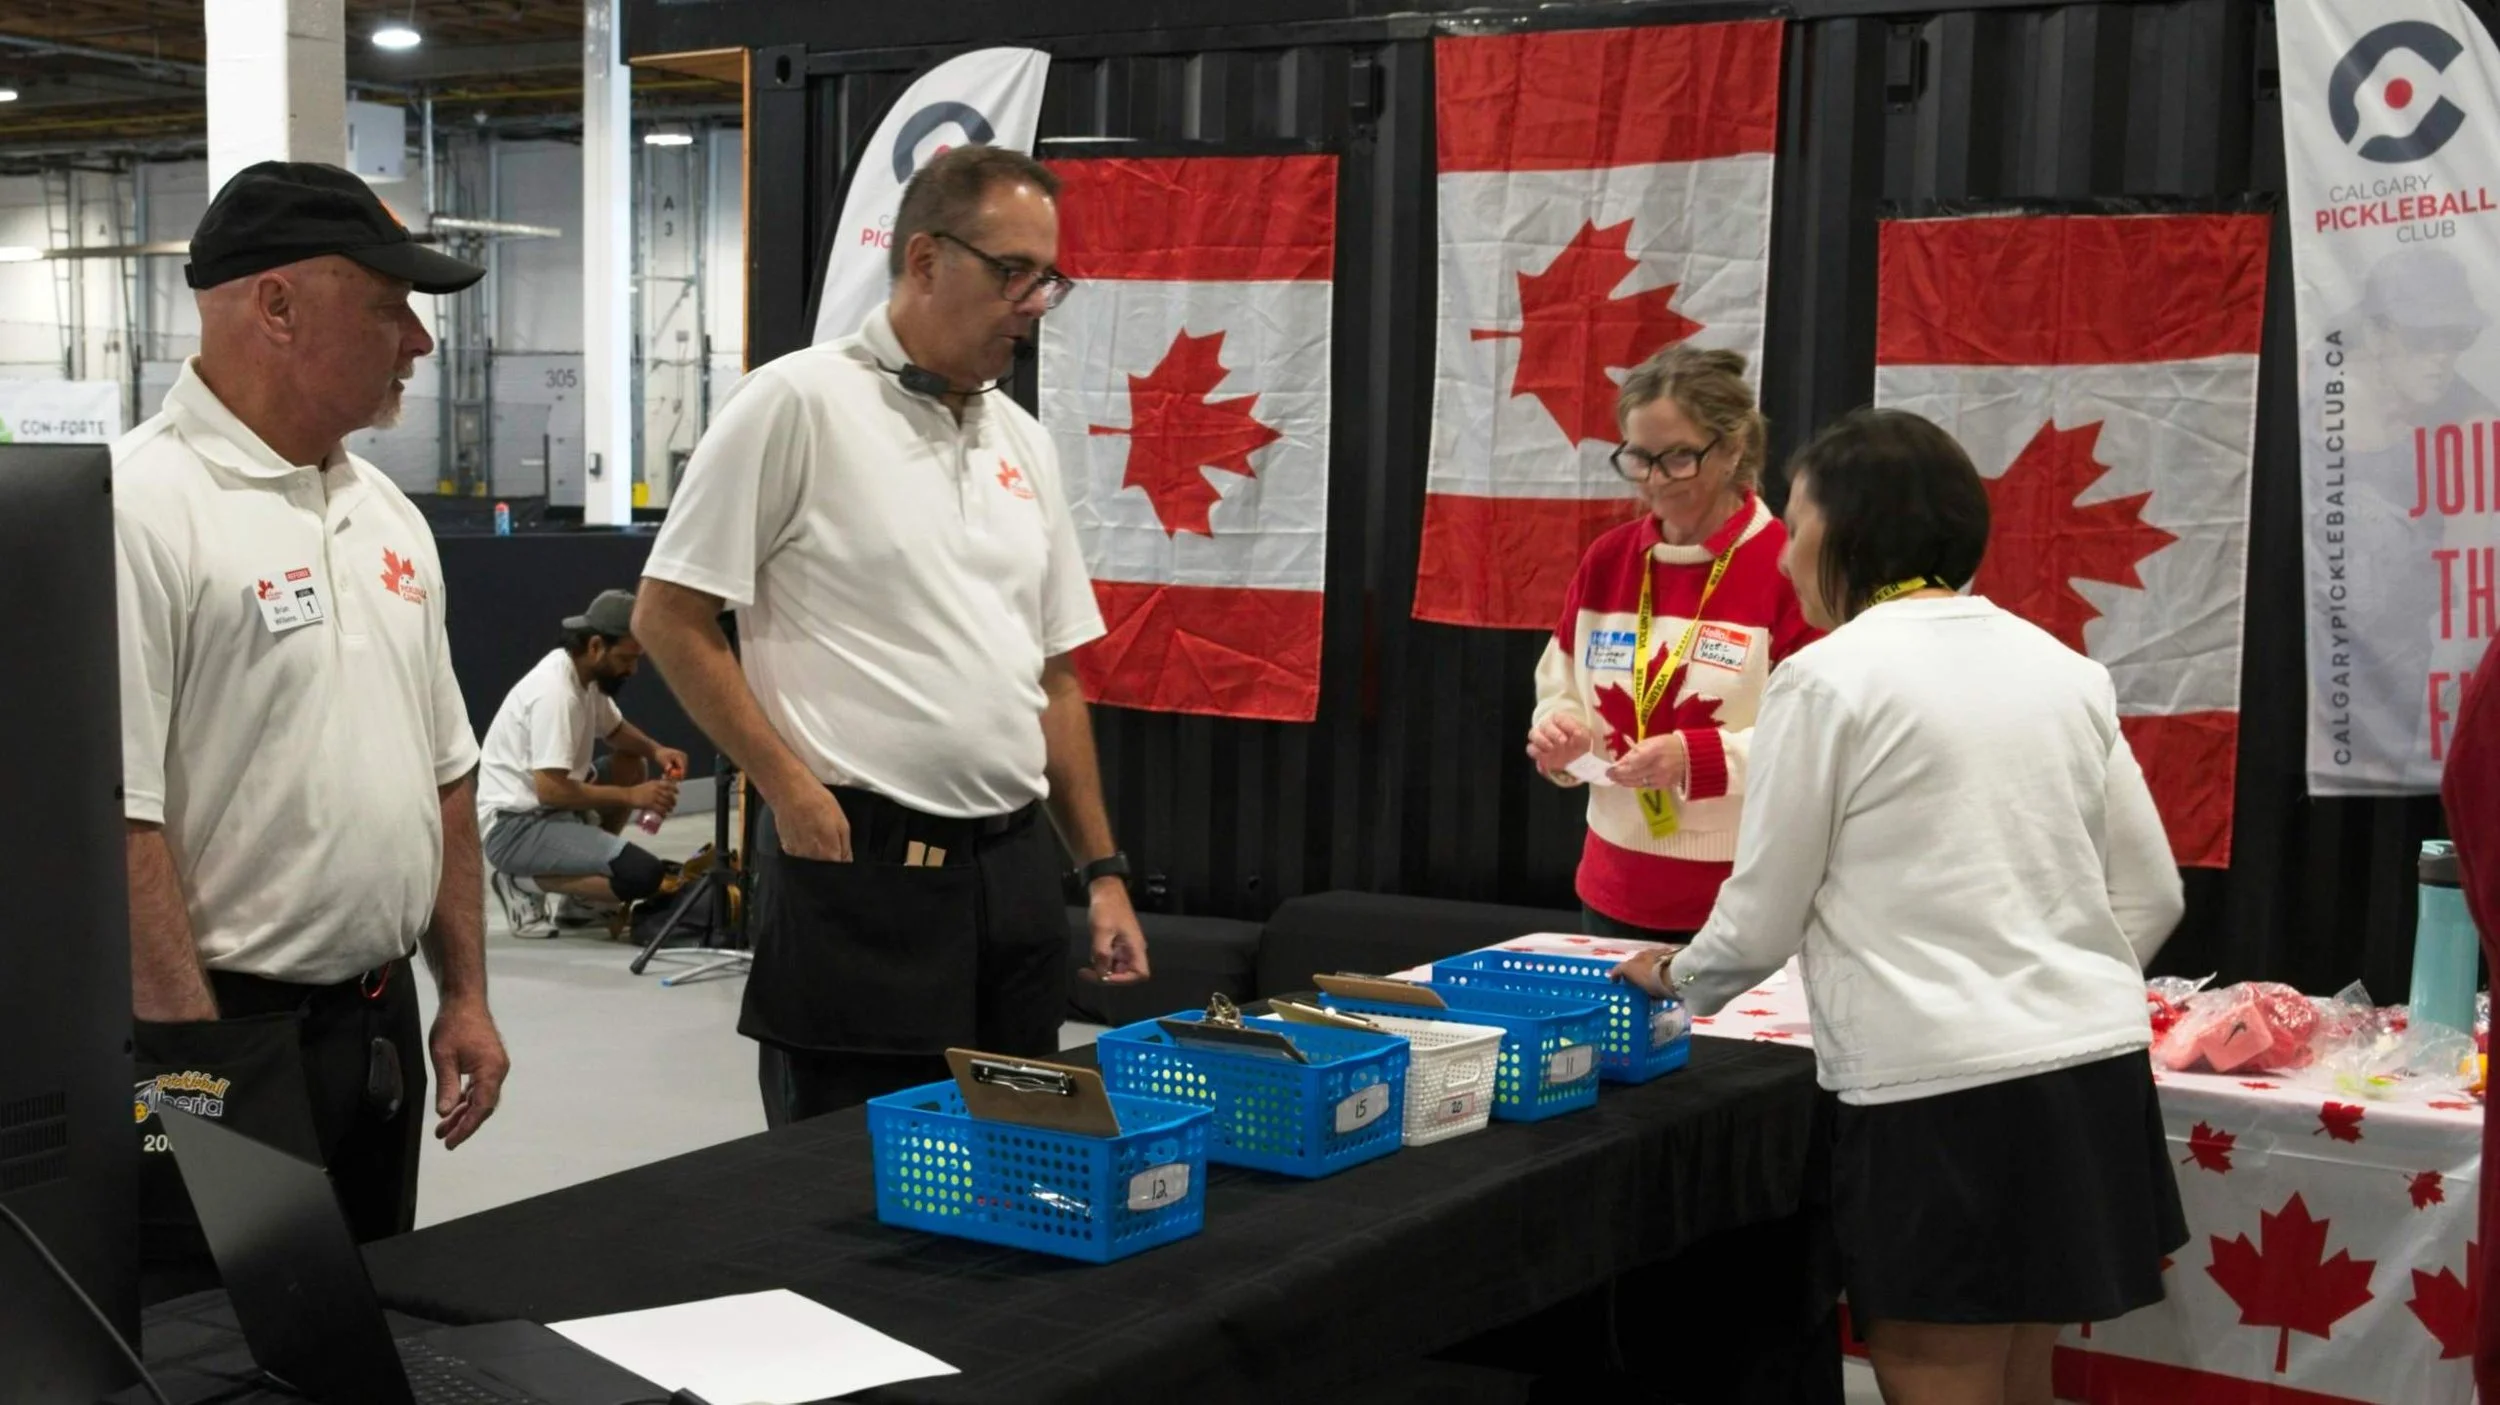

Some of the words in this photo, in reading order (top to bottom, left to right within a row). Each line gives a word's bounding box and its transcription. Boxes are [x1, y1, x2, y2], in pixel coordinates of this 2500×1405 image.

[2329, 174, 2433, 203] CALGARY
[664, 196, 675, 212] A
[2315, 187, 2498, 234] PICKLEBALL
[2396, 219, 2457, 243] CLUB
[545, 368, 577, 389] 305
[20, 419, 106, 436] CON-FORTE
[2324, 328, 2352, 767] CALGARYPICKLEBALLCLUB.CA
[2431, 546, 2497, 640] TH
[306, 600, 315, 614] 1
[1355, 1097, 1368, 1118] 15
[143, 1134, 175, 1152] 20
[1152, 1178, 1168, 1201] 12
